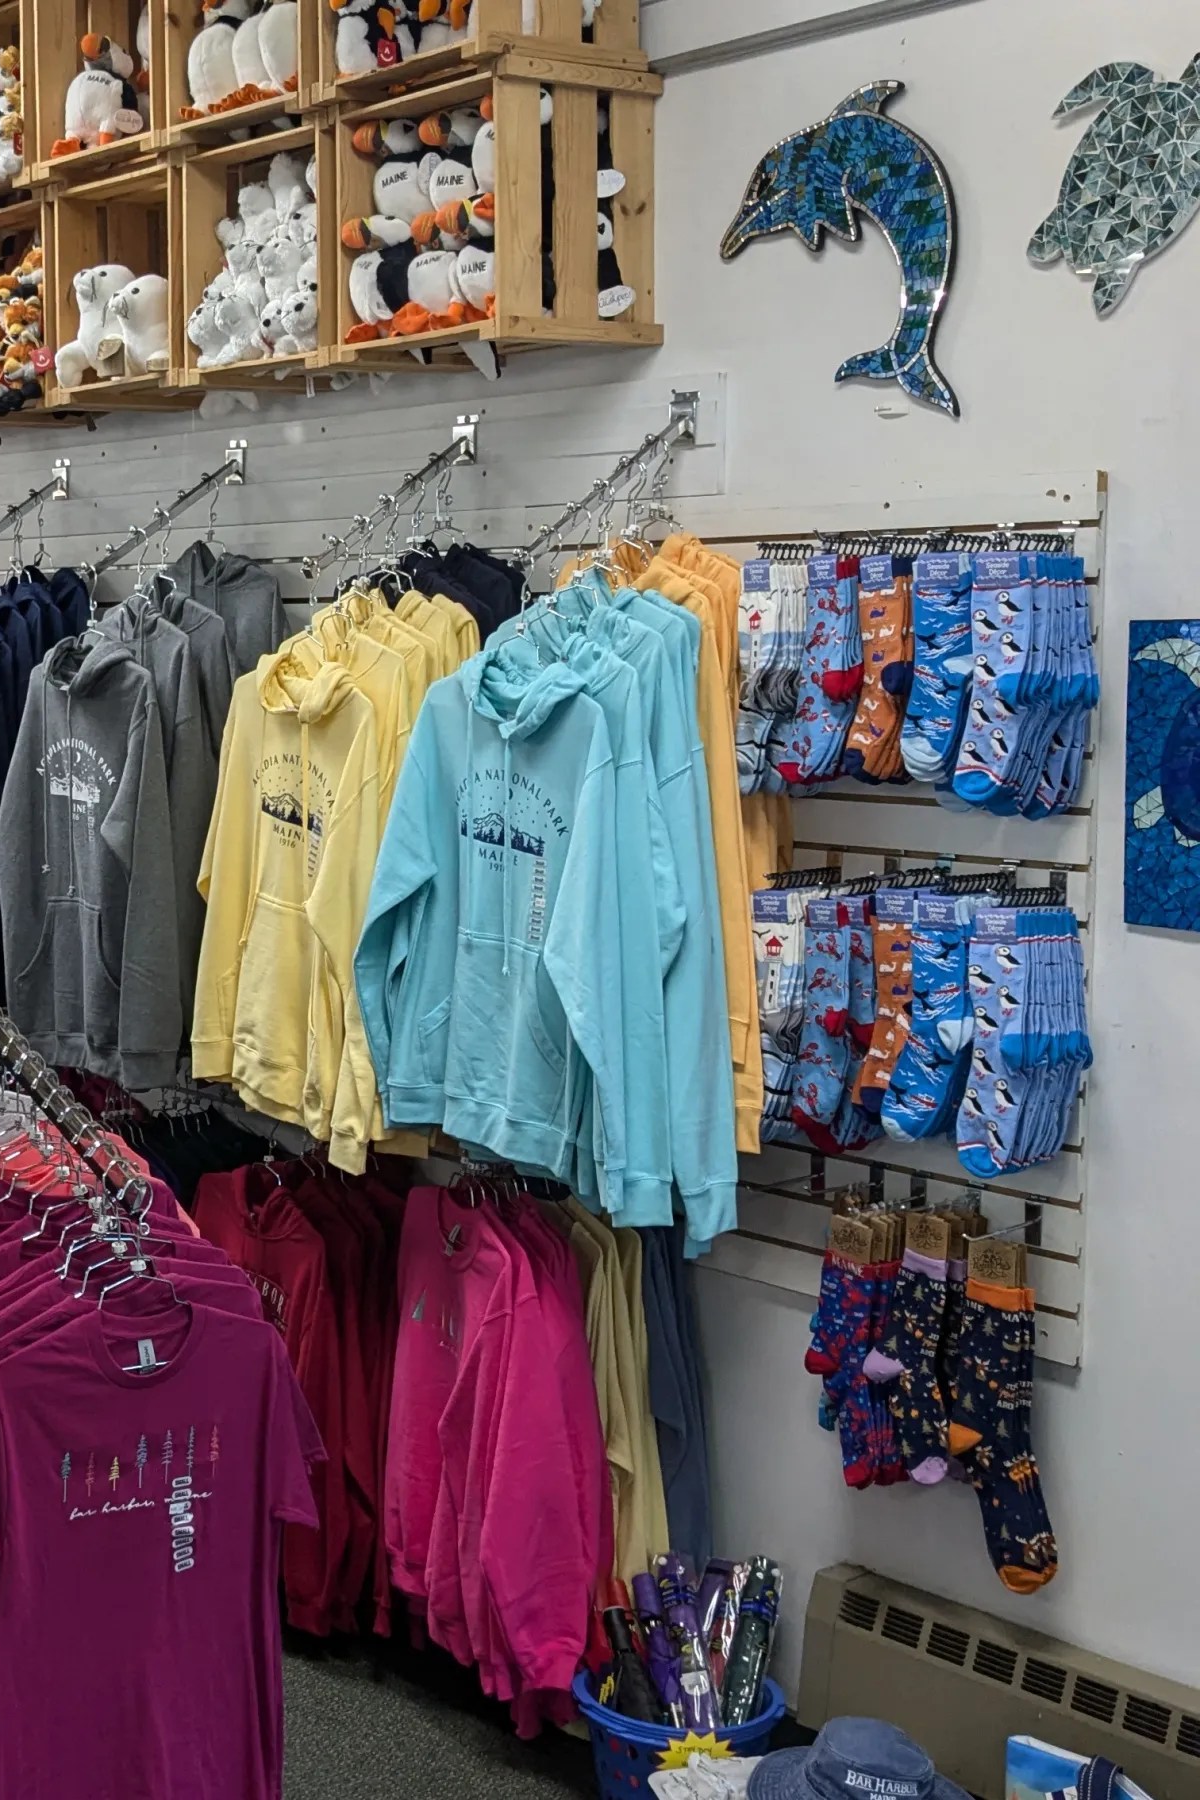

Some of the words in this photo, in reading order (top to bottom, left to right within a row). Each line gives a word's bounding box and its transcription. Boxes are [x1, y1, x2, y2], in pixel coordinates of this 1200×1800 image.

[381, 171, 409, 188] MAINE
[436, 174, 465, 187] MAINE
[927, 562, 950, 570] Seaside
[986, 561, 1009, 569] Seaside
[98, 757, 116, 786] PARK
[485, 769, 543, 801] NATONAL
[543, 797, 570, 838] PARK
[478, 847, 518, 867] MAIE
[845, 1769, 872, 1789] BAR
